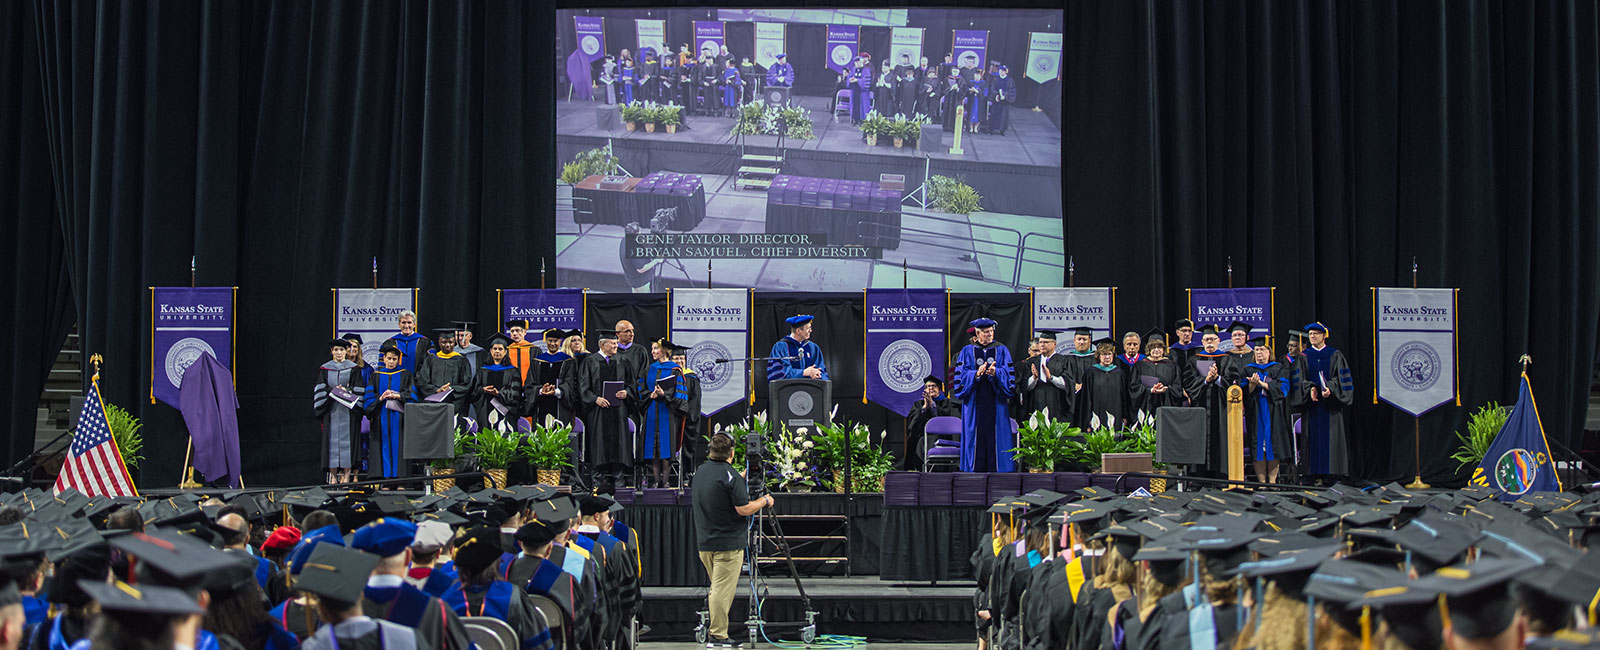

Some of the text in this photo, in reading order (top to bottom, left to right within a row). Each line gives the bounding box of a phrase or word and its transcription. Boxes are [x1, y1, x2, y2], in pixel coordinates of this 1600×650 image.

[635, 234, 813, 246] GENE TAYLOR, DIRECTOR,
[635, 247, 870, 258] BRYAN SAMUEL, CHIEF DIVERSITY
[160, 304, 224, 313] KANSAS STATE
[342, 306, 378, 315] KANSAS
[510, 306, 575, 315] KANSAS STATE
[677, 305, 742, 315] KANSAS STATE
[872, 305, 938, 315] KANSAS STATE
[1039, 305, 1104, 314] KANSAS STATE
[1198, 305, 1263, 315] KANSAS STATE
[1383, 305, 1448, 315] KANSAS STATE
